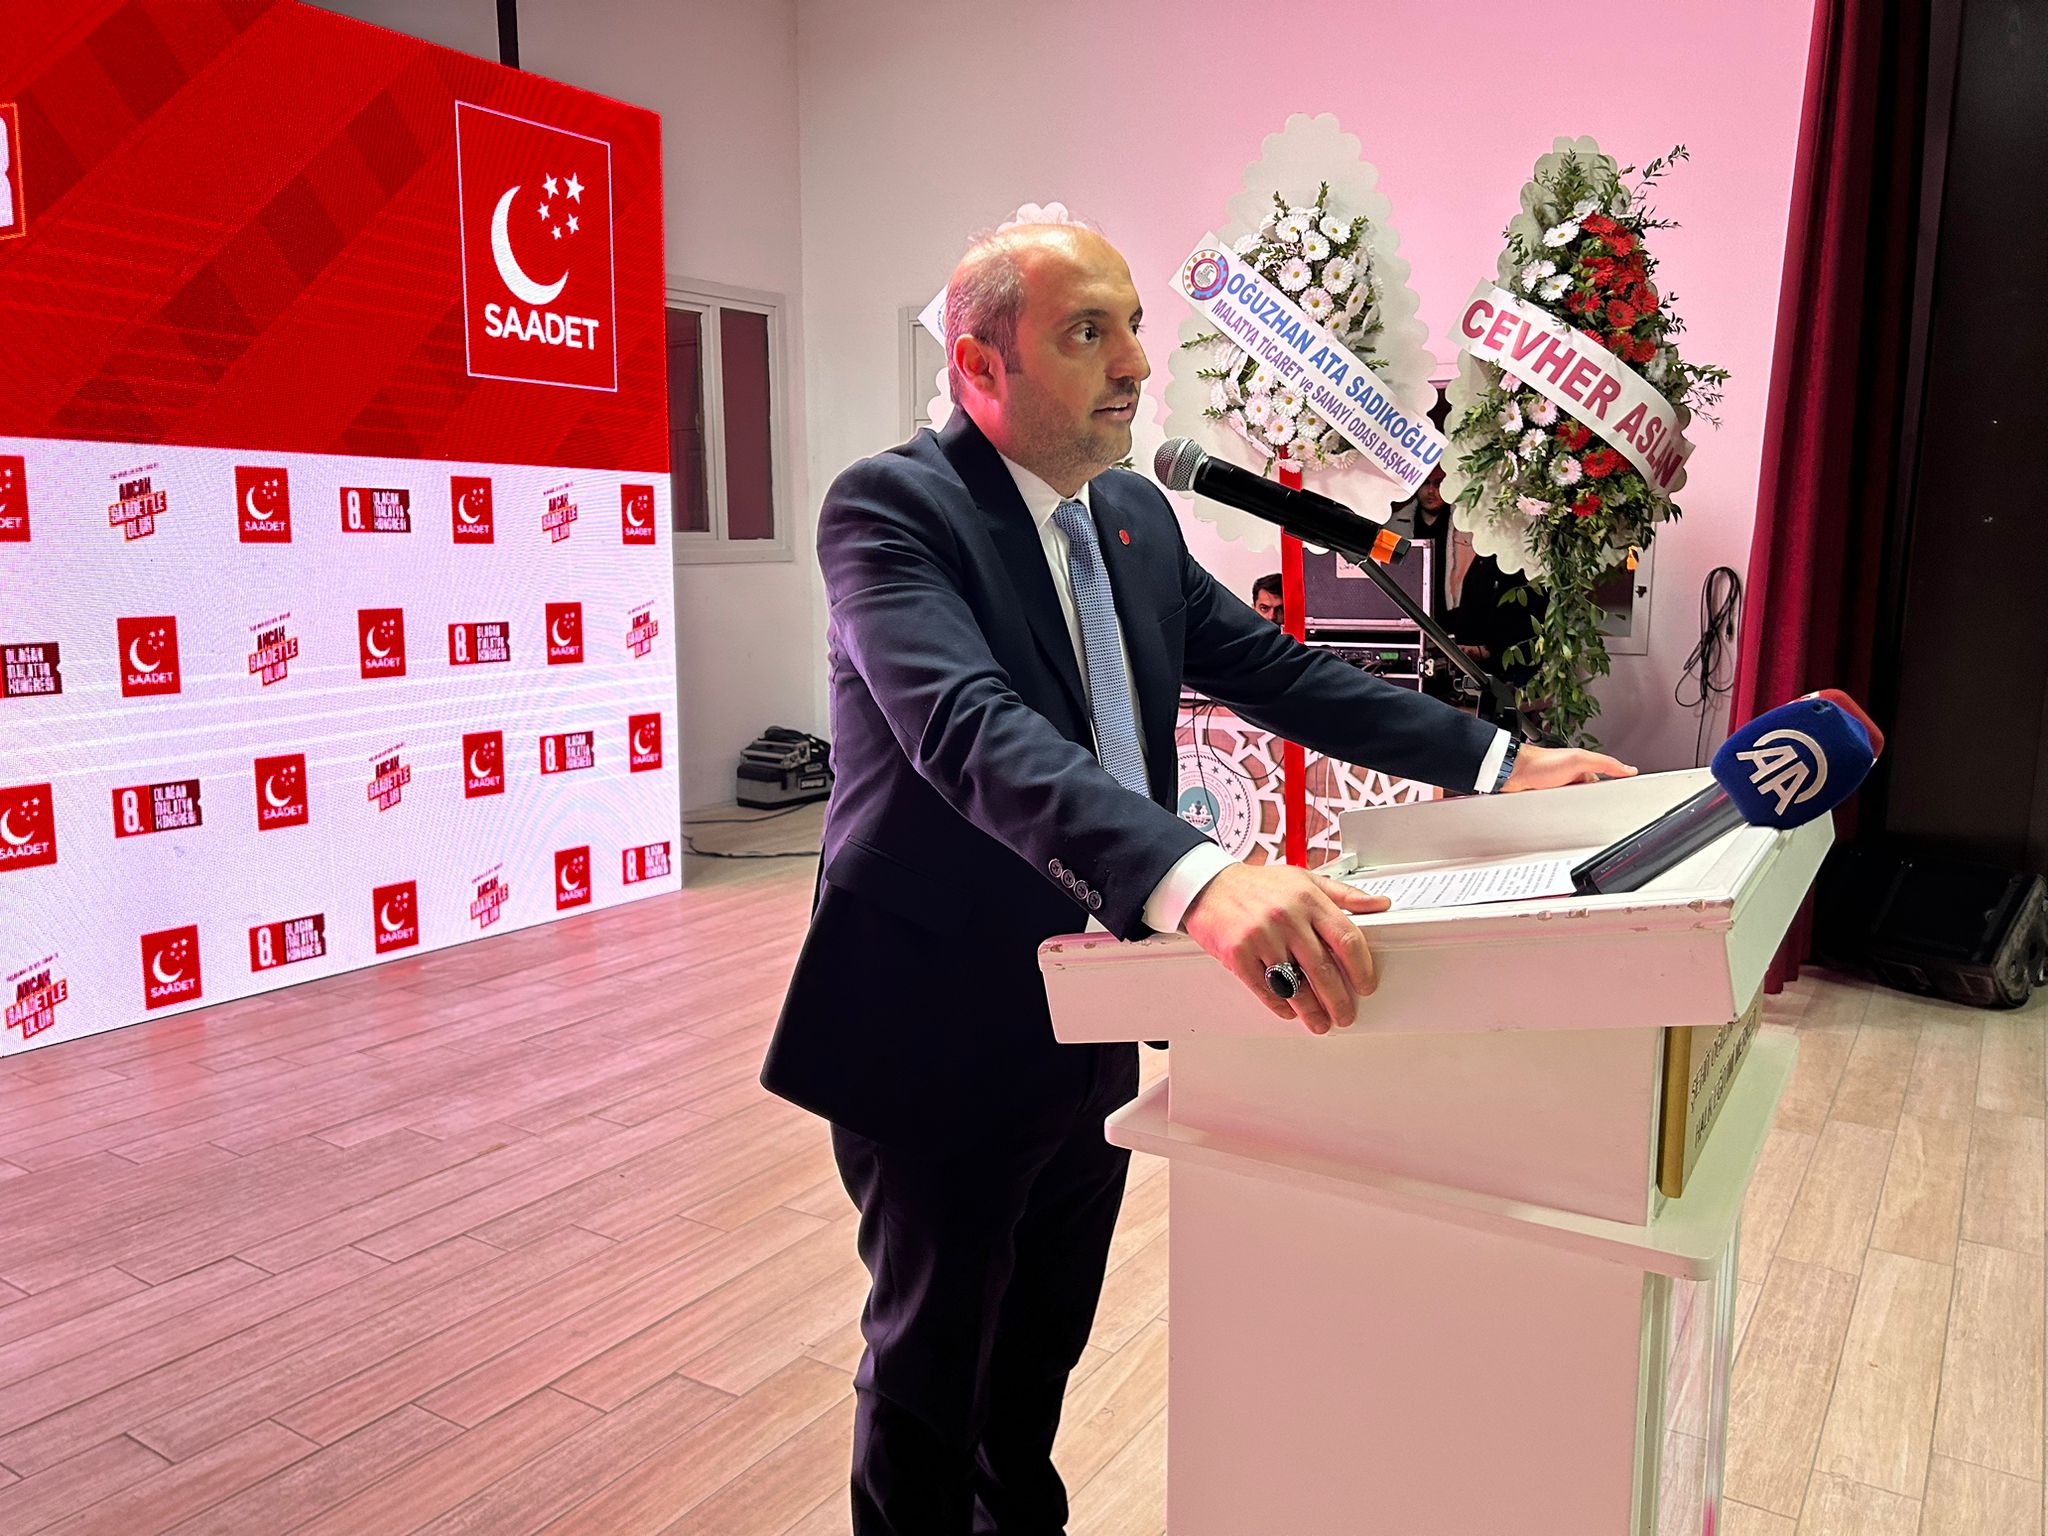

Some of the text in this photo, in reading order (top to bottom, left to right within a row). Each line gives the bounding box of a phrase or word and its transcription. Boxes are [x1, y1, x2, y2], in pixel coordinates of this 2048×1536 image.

[484, 303, 599, 351] SAADET
[1227, 273, 1443, 464] OĞUZHAN ATA SADIKOĞLU
[1211, 299, 1423, 485] MALATYA TİCARET ve SANAYİ ODASI BAŞKANI
[1462, 299, 1683, 488] CEVHER ASLAN
[244, 520, 286, 531] SAADET
[457, 523, 489, 534] SAADET
[551, 645, 580, 657] SAADET
[365, 657, 401, 668] SAADET
[128, 672, 174, 685] SAADET
[469, 776, 501, 789] SAADET
[1736, 744, 1810, 817] AA
[263, 804, 303, 819] SAADET
[559, 887, 588, 901] SAADET
[380, 927, 414, 944] SAADET
[150, 978, 196, 998] SAADET
